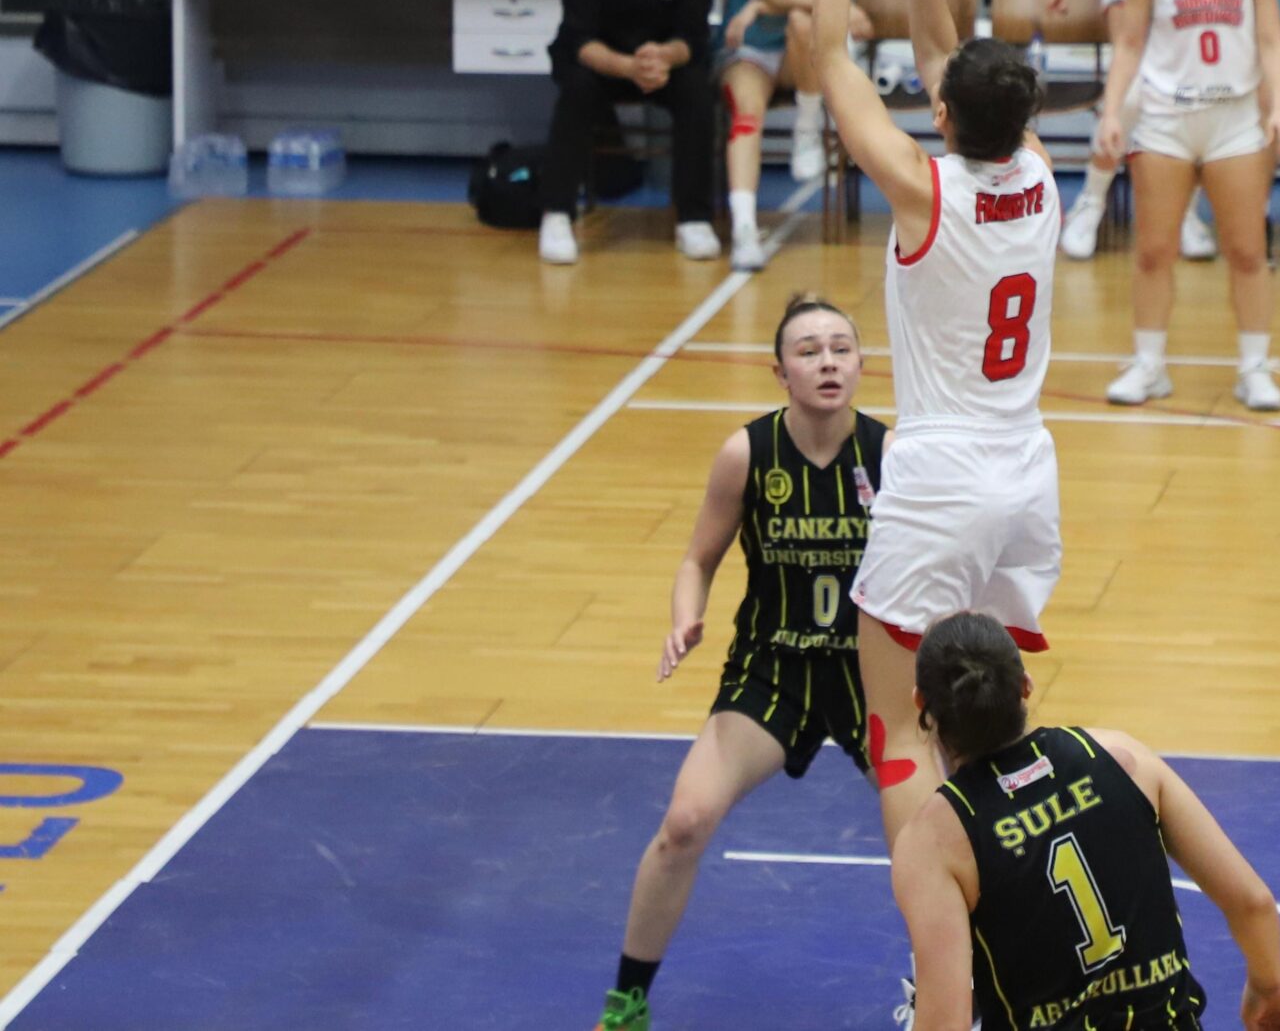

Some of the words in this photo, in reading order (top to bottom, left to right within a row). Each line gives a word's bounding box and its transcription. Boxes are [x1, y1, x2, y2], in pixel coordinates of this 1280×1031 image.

[1200, 30, 1220, 64] 0
[982, 272, 1037, 383] 8
[813, 574, 840, 627] 0
[993, 776, 1103, 858] ŞULE
[1046, 831, 1127, 975] 1
